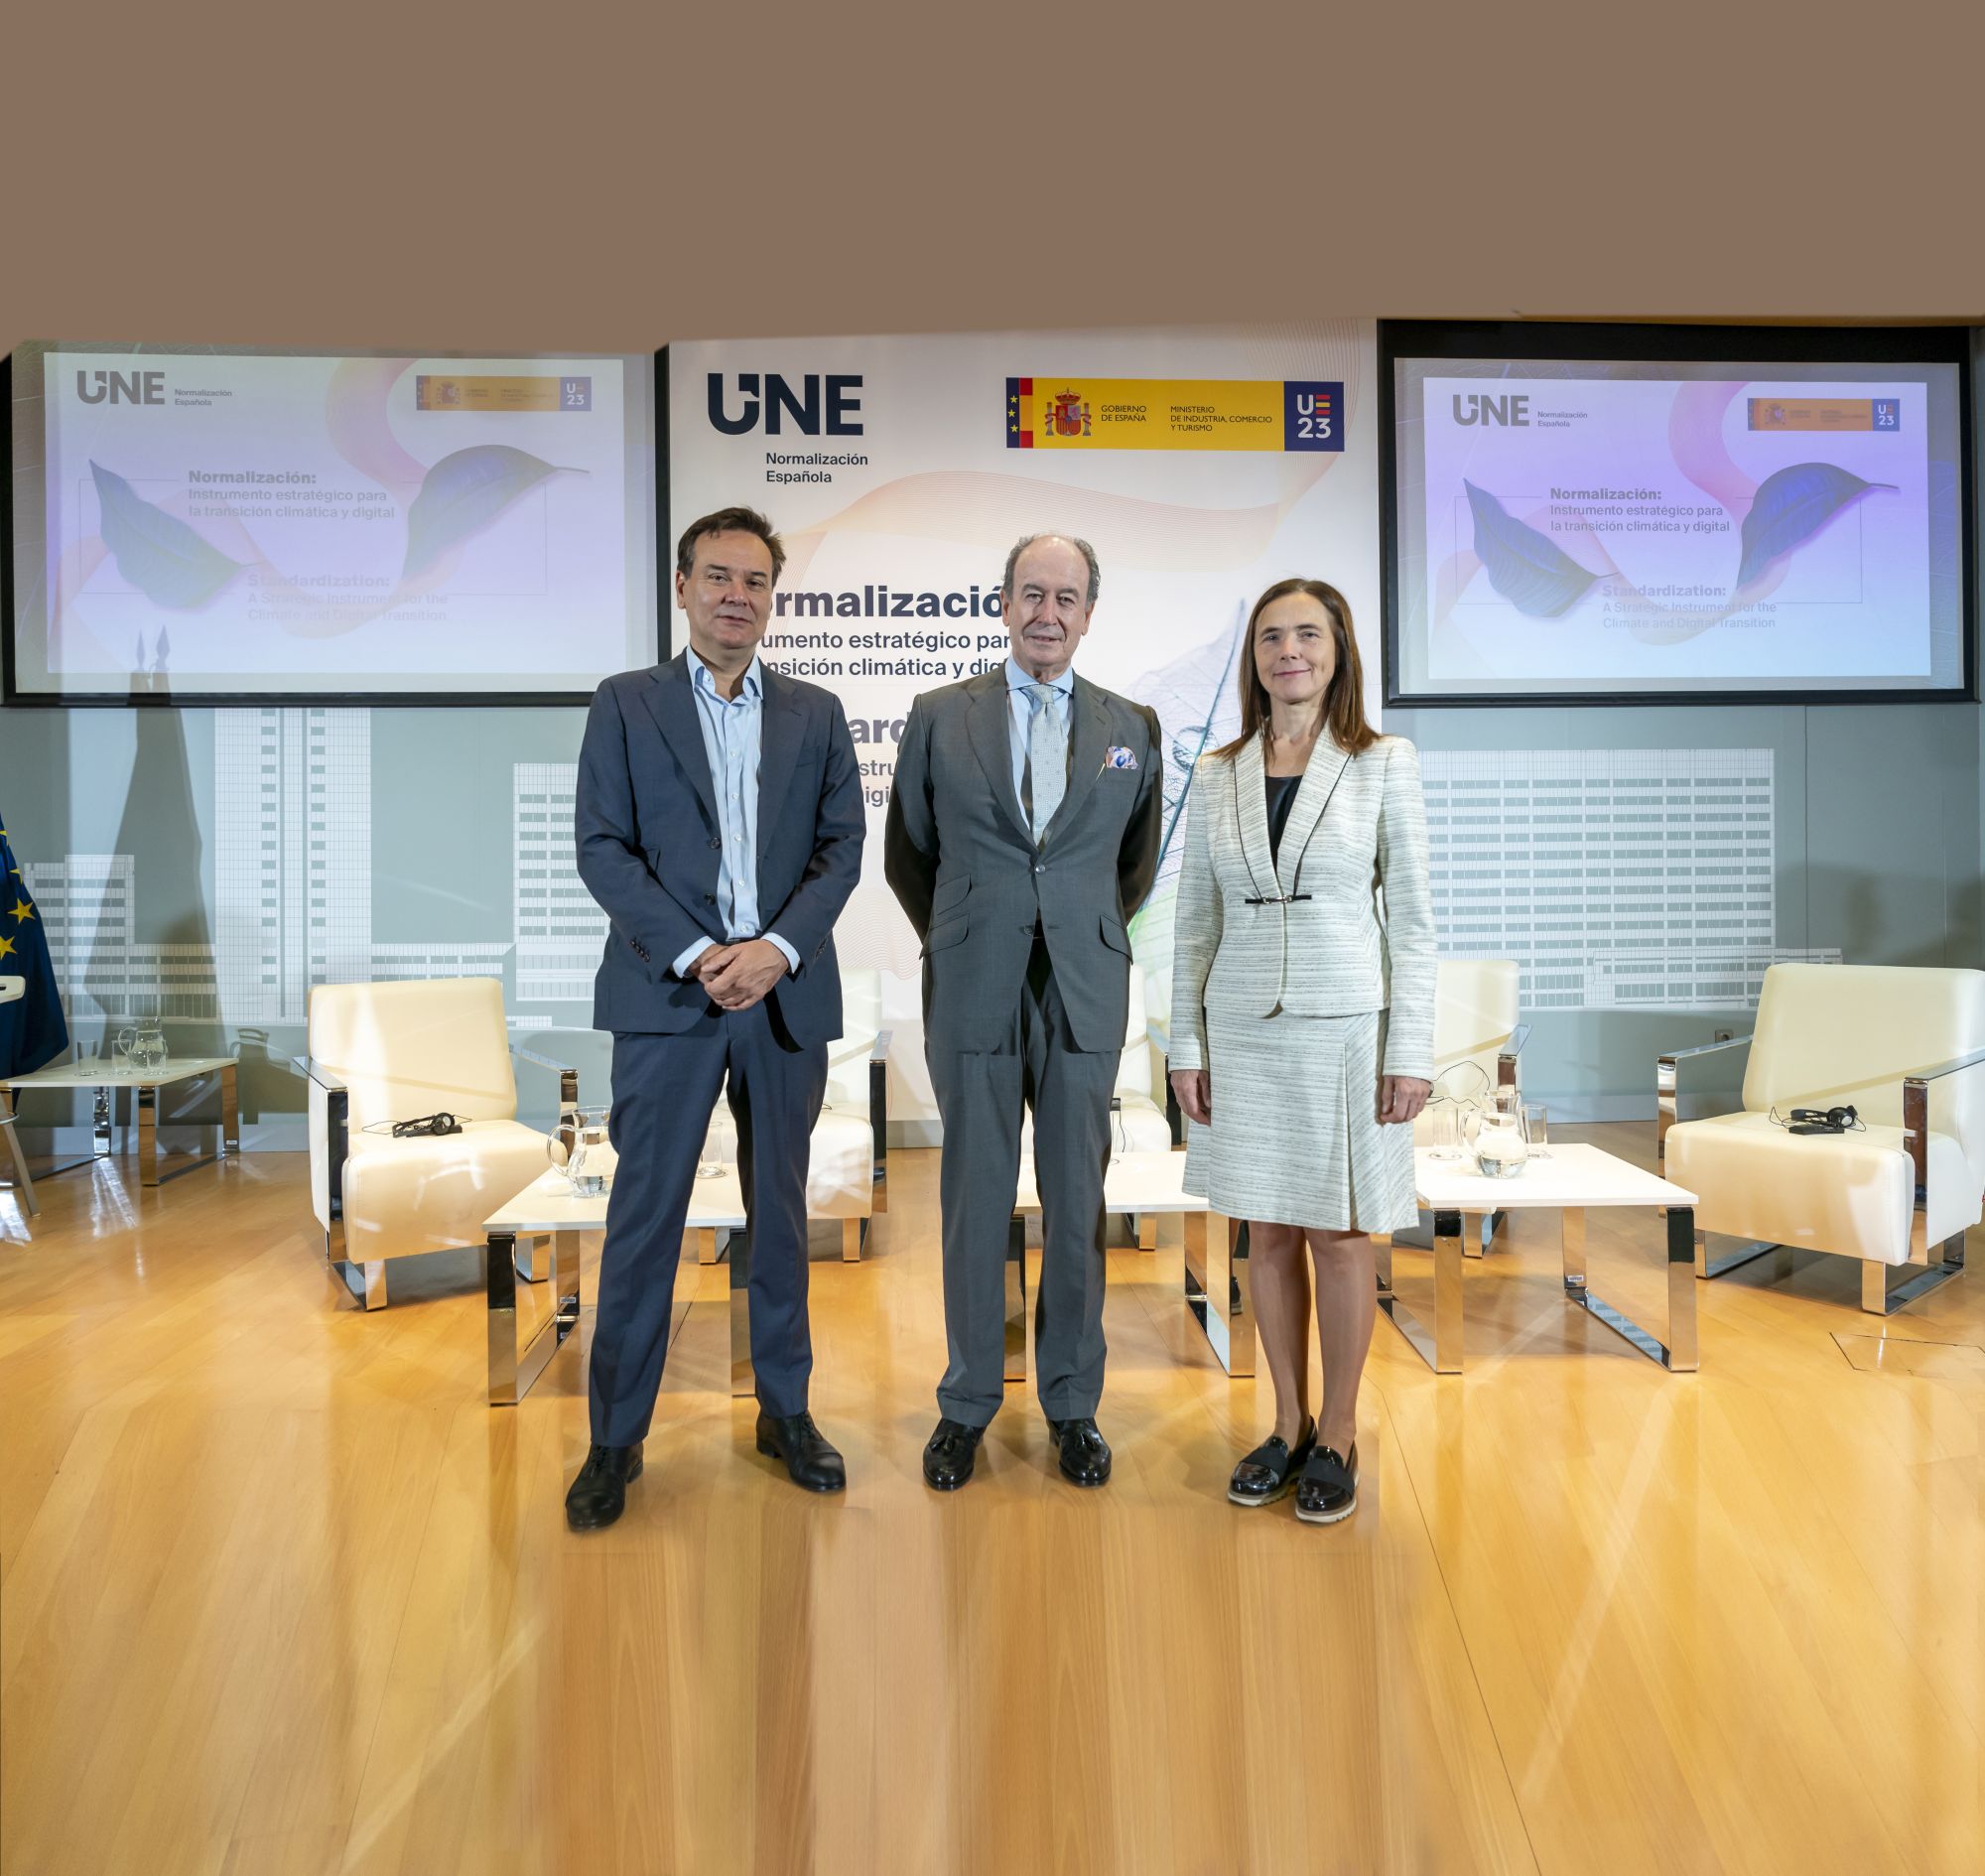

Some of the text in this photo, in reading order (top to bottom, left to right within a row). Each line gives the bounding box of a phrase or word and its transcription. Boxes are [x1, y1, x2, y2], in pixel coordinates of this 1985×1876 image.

[77, 370, 166, 405] UNE
[567, 394, 585, 405] 23
[708, 373, 863, 436] UNE
[1101, 404, 1147, 413] GOBIERNO
[1170, 405, 1215, 414] MINISTERIO
[1453, 394, 1529, 427] UNE
[1115, 413, 1146, 422] ESPAÑA
[1878, 415, 1895, 426] 23
[1297, 417, 1332, 439] 23
[766, 453, 868, 466] Normalización
[189, 470, 317, 484] Normalización:
[766, 470, 832, 485] Española
[189, 489, 387, 504] Instrumento estratégico para
[1550, 487, 1661, 500] Normalización:
[189, 505, 395, 521] la transición climática y digital
[1550, 505, 1723, 518] Instrumento estratégico para
[1550, 521, 1730, 534] la transición climática y digital
[1602, 584, 1727, 597] Standardization:
[776, 585, 1002, 617] rmalizació
[1603, 603, 1611, 613] A
[1614, 602, 1668, 614] Strategic
[1757, 602, 1777, 613] the
[1603, 617, 1649, 629] Climate
[1652, 617, 1675, 629] and
[1718, 617, 1776, 629] Transition
[761, 631, 1010, 652] umento estratégico par
[767, 658, 843, 676] nsición
[849, 658, 947, 676] climática
[953, 662, 965, 679] y
[865, 786, 890, 807] igi
